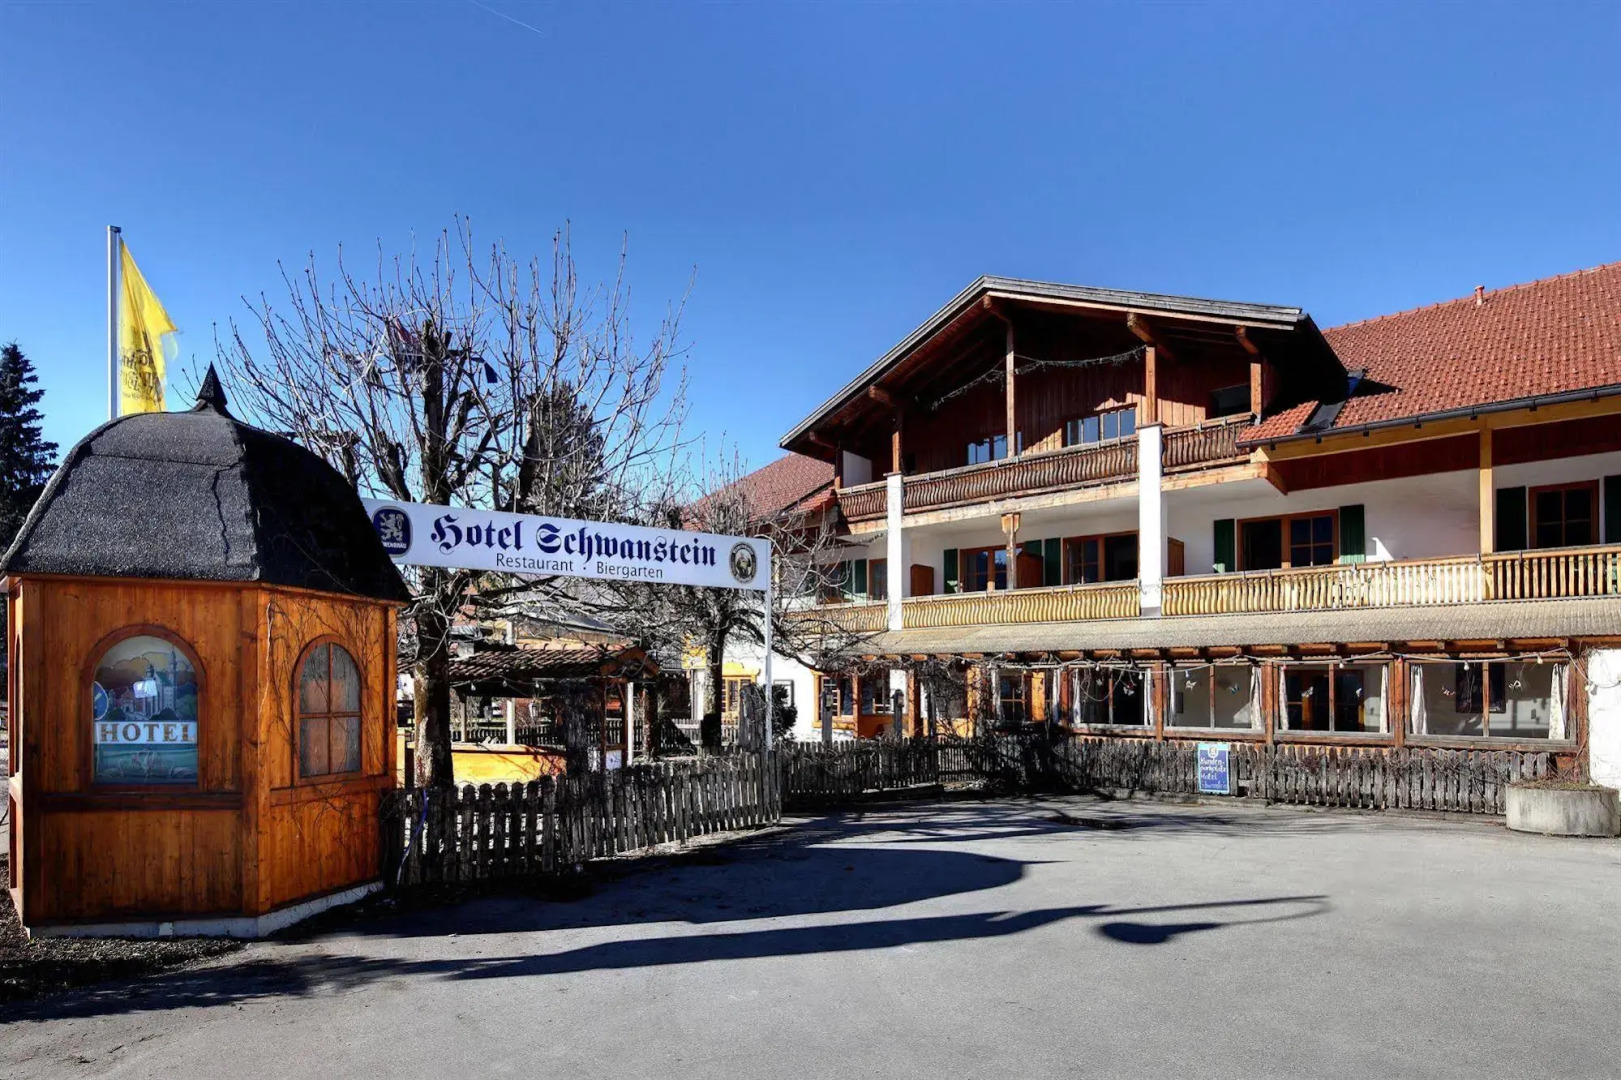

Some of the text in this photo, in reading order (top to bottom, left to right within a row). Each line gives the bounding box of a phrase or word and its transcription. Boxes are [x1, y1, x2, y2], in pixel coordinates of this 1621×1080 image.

[431, 513, 524, 555] Hotel
[536, 523, 716, 567] Schwanstein
[496, 552, 663, 579] Restaurant Biergarten
[100, 723, 196, 742] HOTEL
